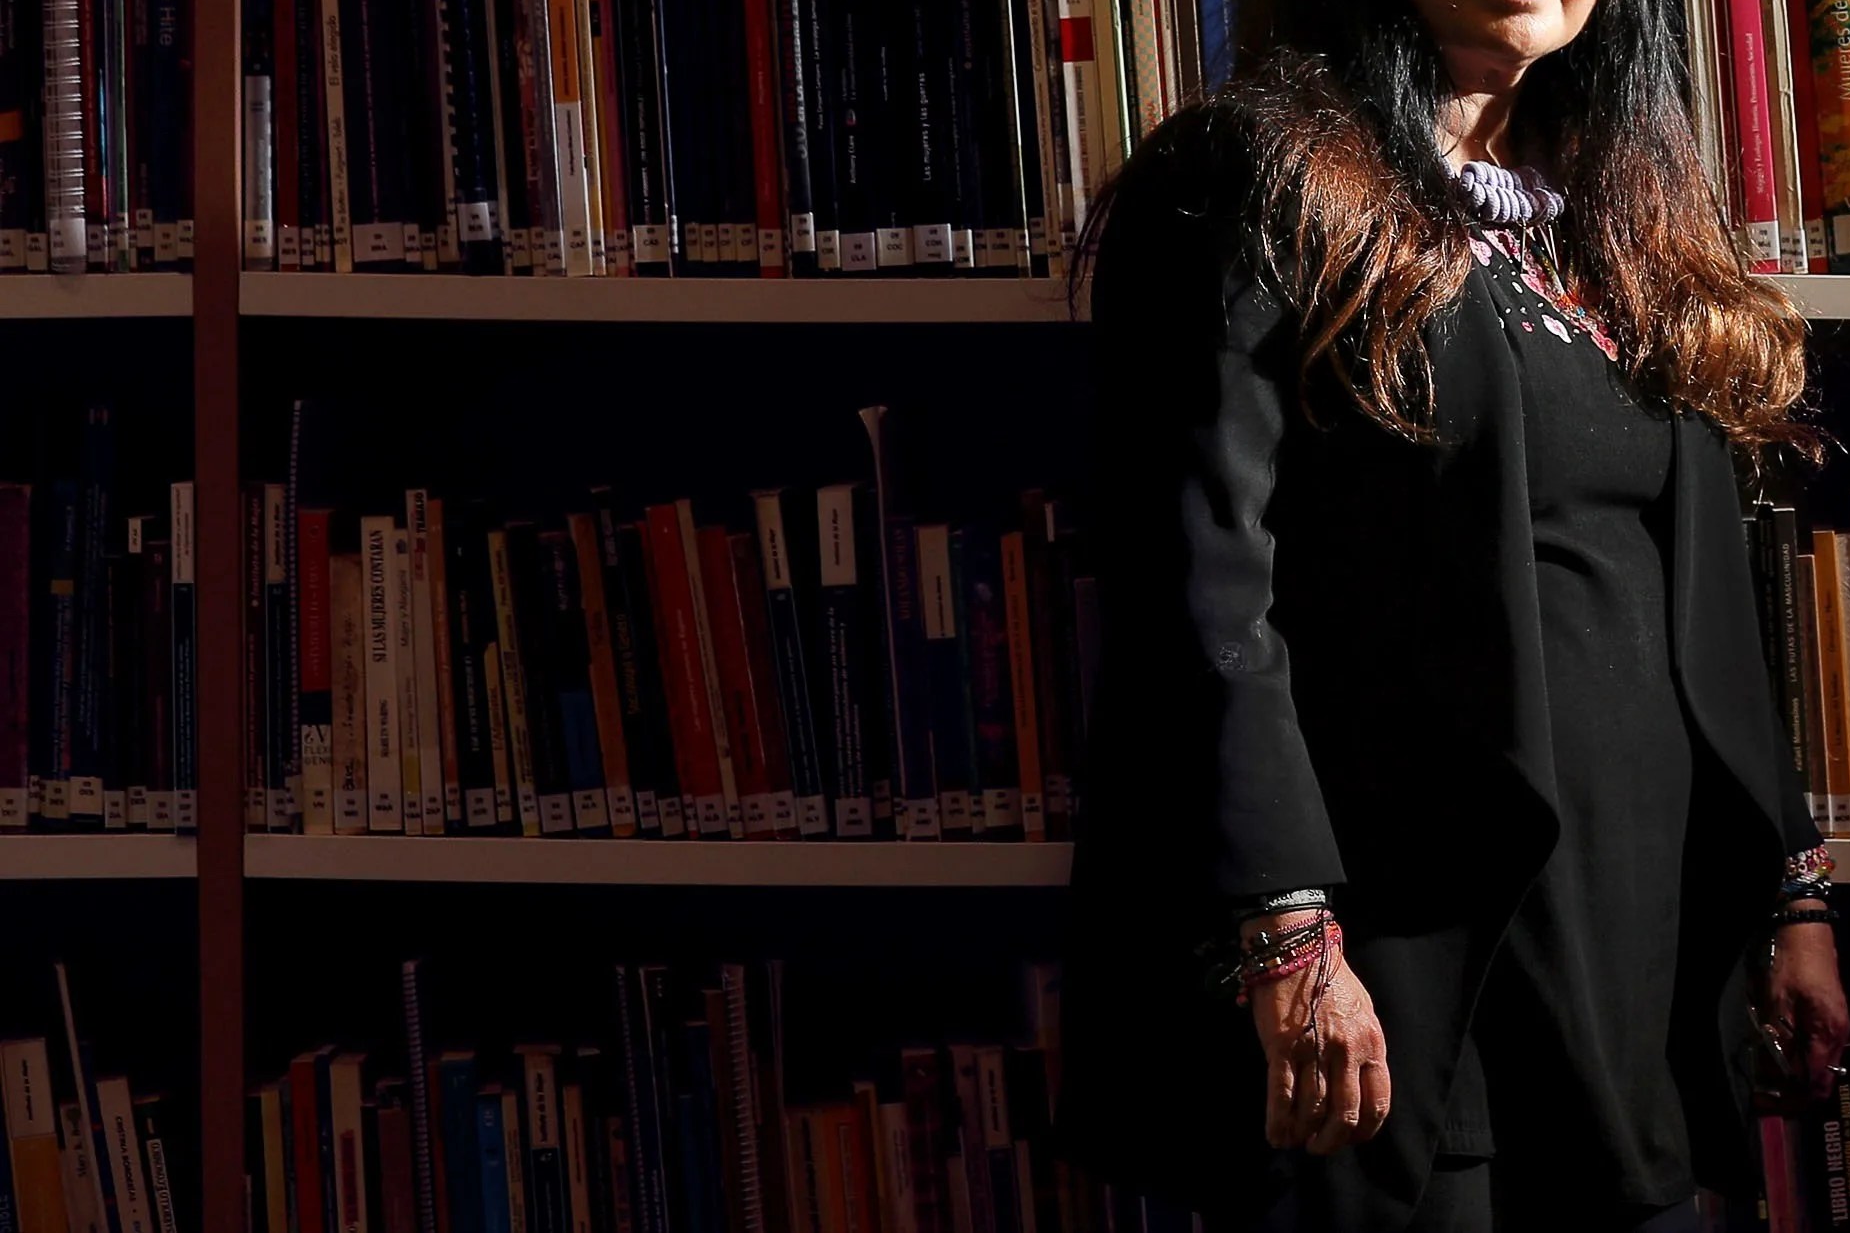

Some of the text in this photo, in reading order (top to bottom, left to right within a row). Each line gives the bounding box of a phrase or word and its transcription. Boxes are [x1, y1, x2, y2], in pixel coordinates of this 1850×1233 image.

[156, 5, 175, 46] Hite
[369, 529, 386, 662] SI LAS MUJERES CONTARAN
[1781, 542, 1798, 683] LAS RUTAS DE LA MASCULINIDAD
[1823, 1120, 1849, 1221] LIBRO NEGRO
